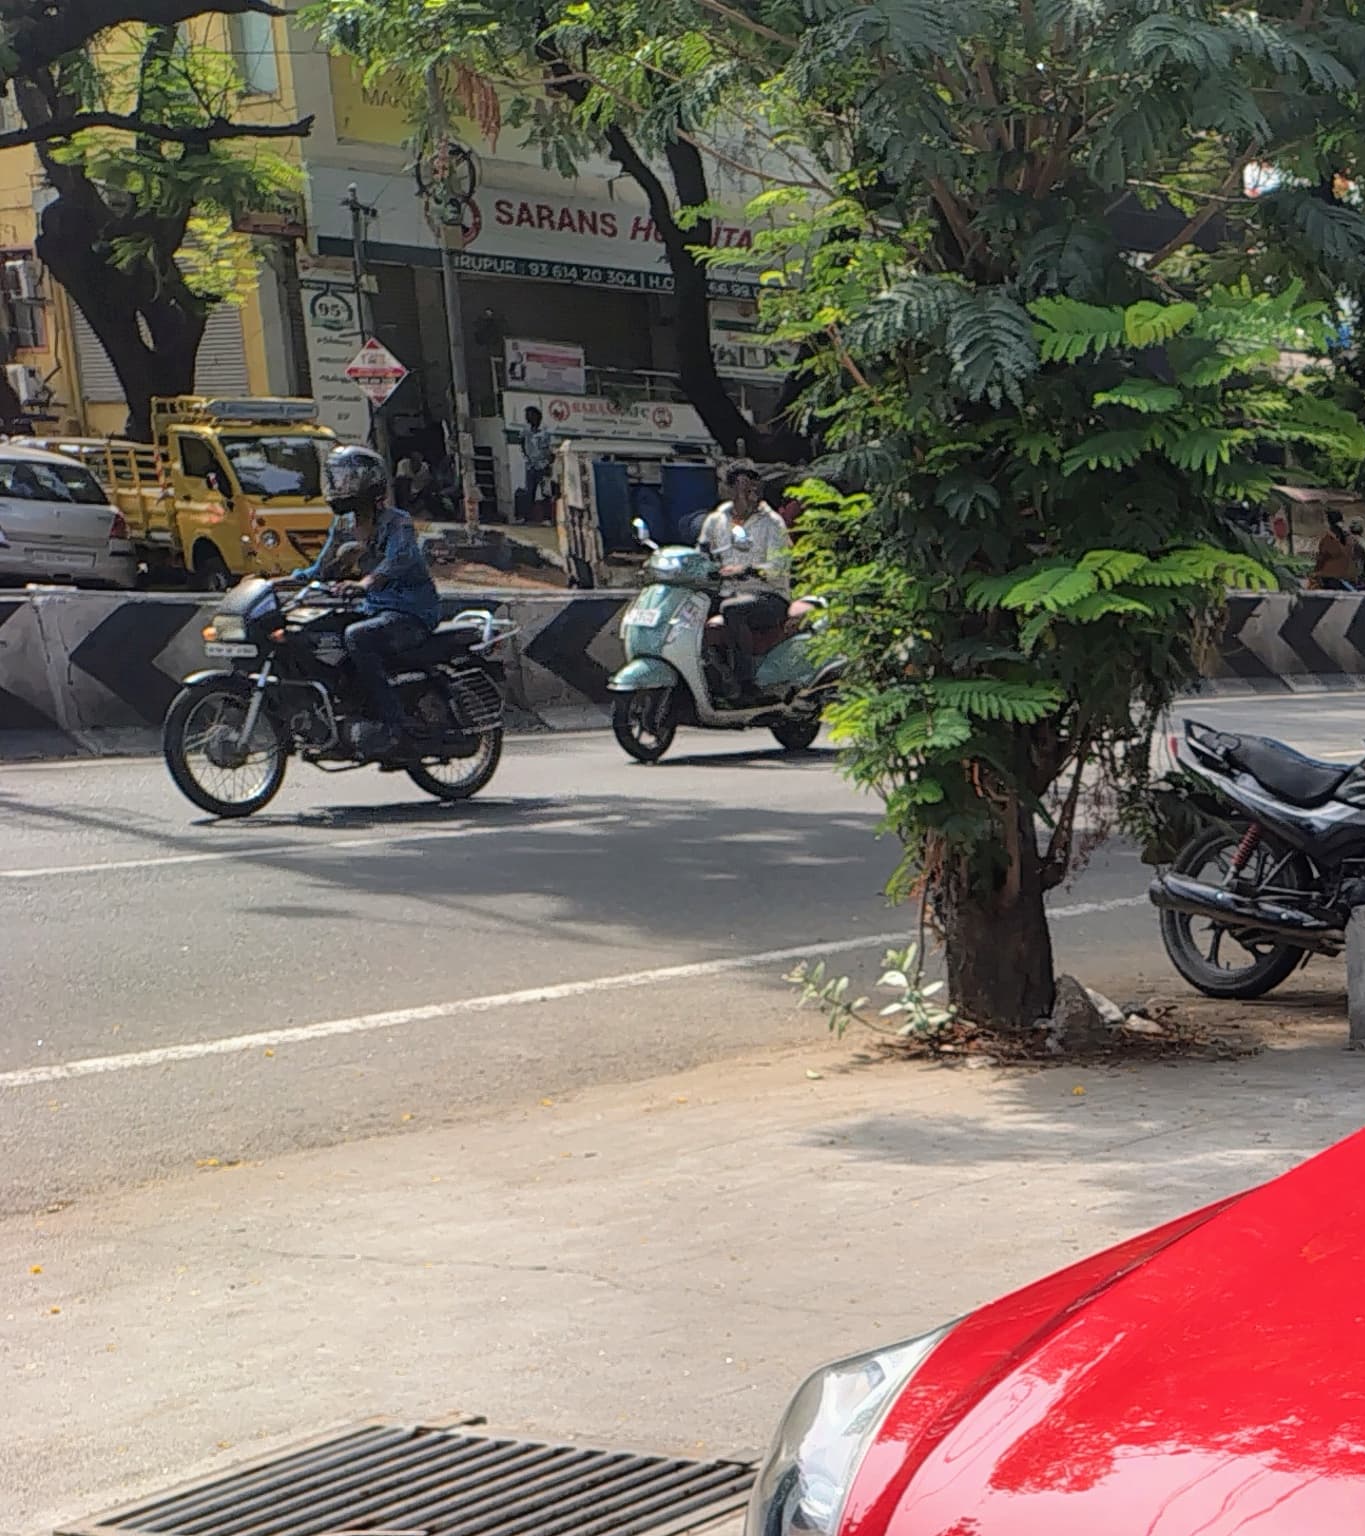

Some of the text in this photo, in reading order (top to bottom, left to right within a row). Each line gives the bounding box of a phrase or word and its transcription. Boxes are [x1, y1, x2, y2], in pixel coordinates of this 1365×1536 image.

[494, 199, 619, 238] SARANS
[454, 254, 517, 275] IRUPUR
[527, 262, 550, 277] 93
[551, 264, 579, 280] 614
[581, 267, 603, 283] 20
[605, 270, 638, 286] 304
